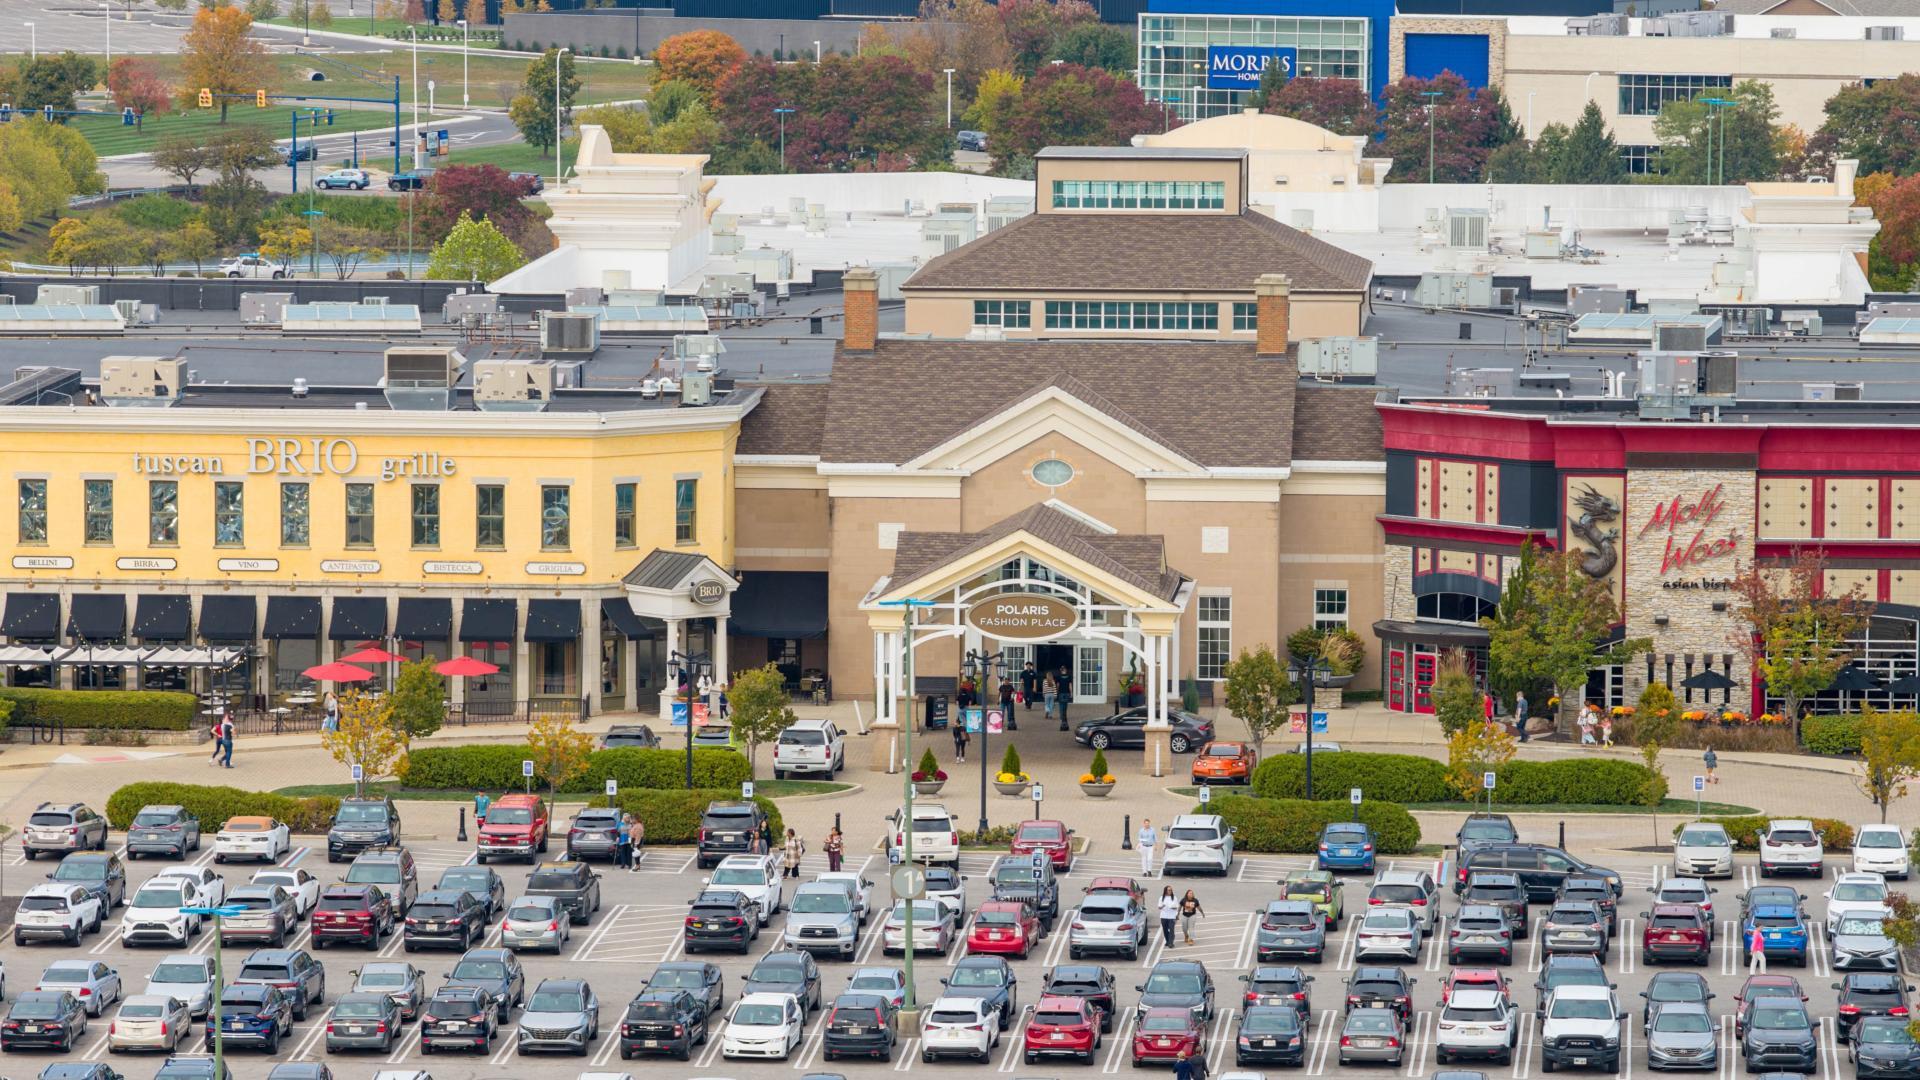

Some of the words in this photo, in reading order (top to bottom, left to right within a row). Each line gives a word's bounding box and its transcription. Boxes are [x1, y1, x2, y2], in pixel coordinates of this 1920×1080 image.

[1213, 54, 1290, 72] MORRIS
[132, 452, 223, 475] tuscan
[246, 438, 358, 475] BRIO
[381, 451, 457, 482] grille
[1638, 483, 1725, 539] Molly
[134, 560, 160, 568] BIRRA
[238, 561, 259, 569] VINO
[327, 562, 375, 570] ANTIPASTO
[433, 564, 473, 572] BISTECCA
[538, 565, 573, 573] GRIGLIA
[1662, 578, 1699, 590] asian
[1703, 578, 1729, 592] bist
[699, 585, 722, 597] BRIO
[996, 605, 1049, 615] POLARIS
[980, 617, 1027, 626] FASHION
[1031, 618, 1066, 627] PLACE
